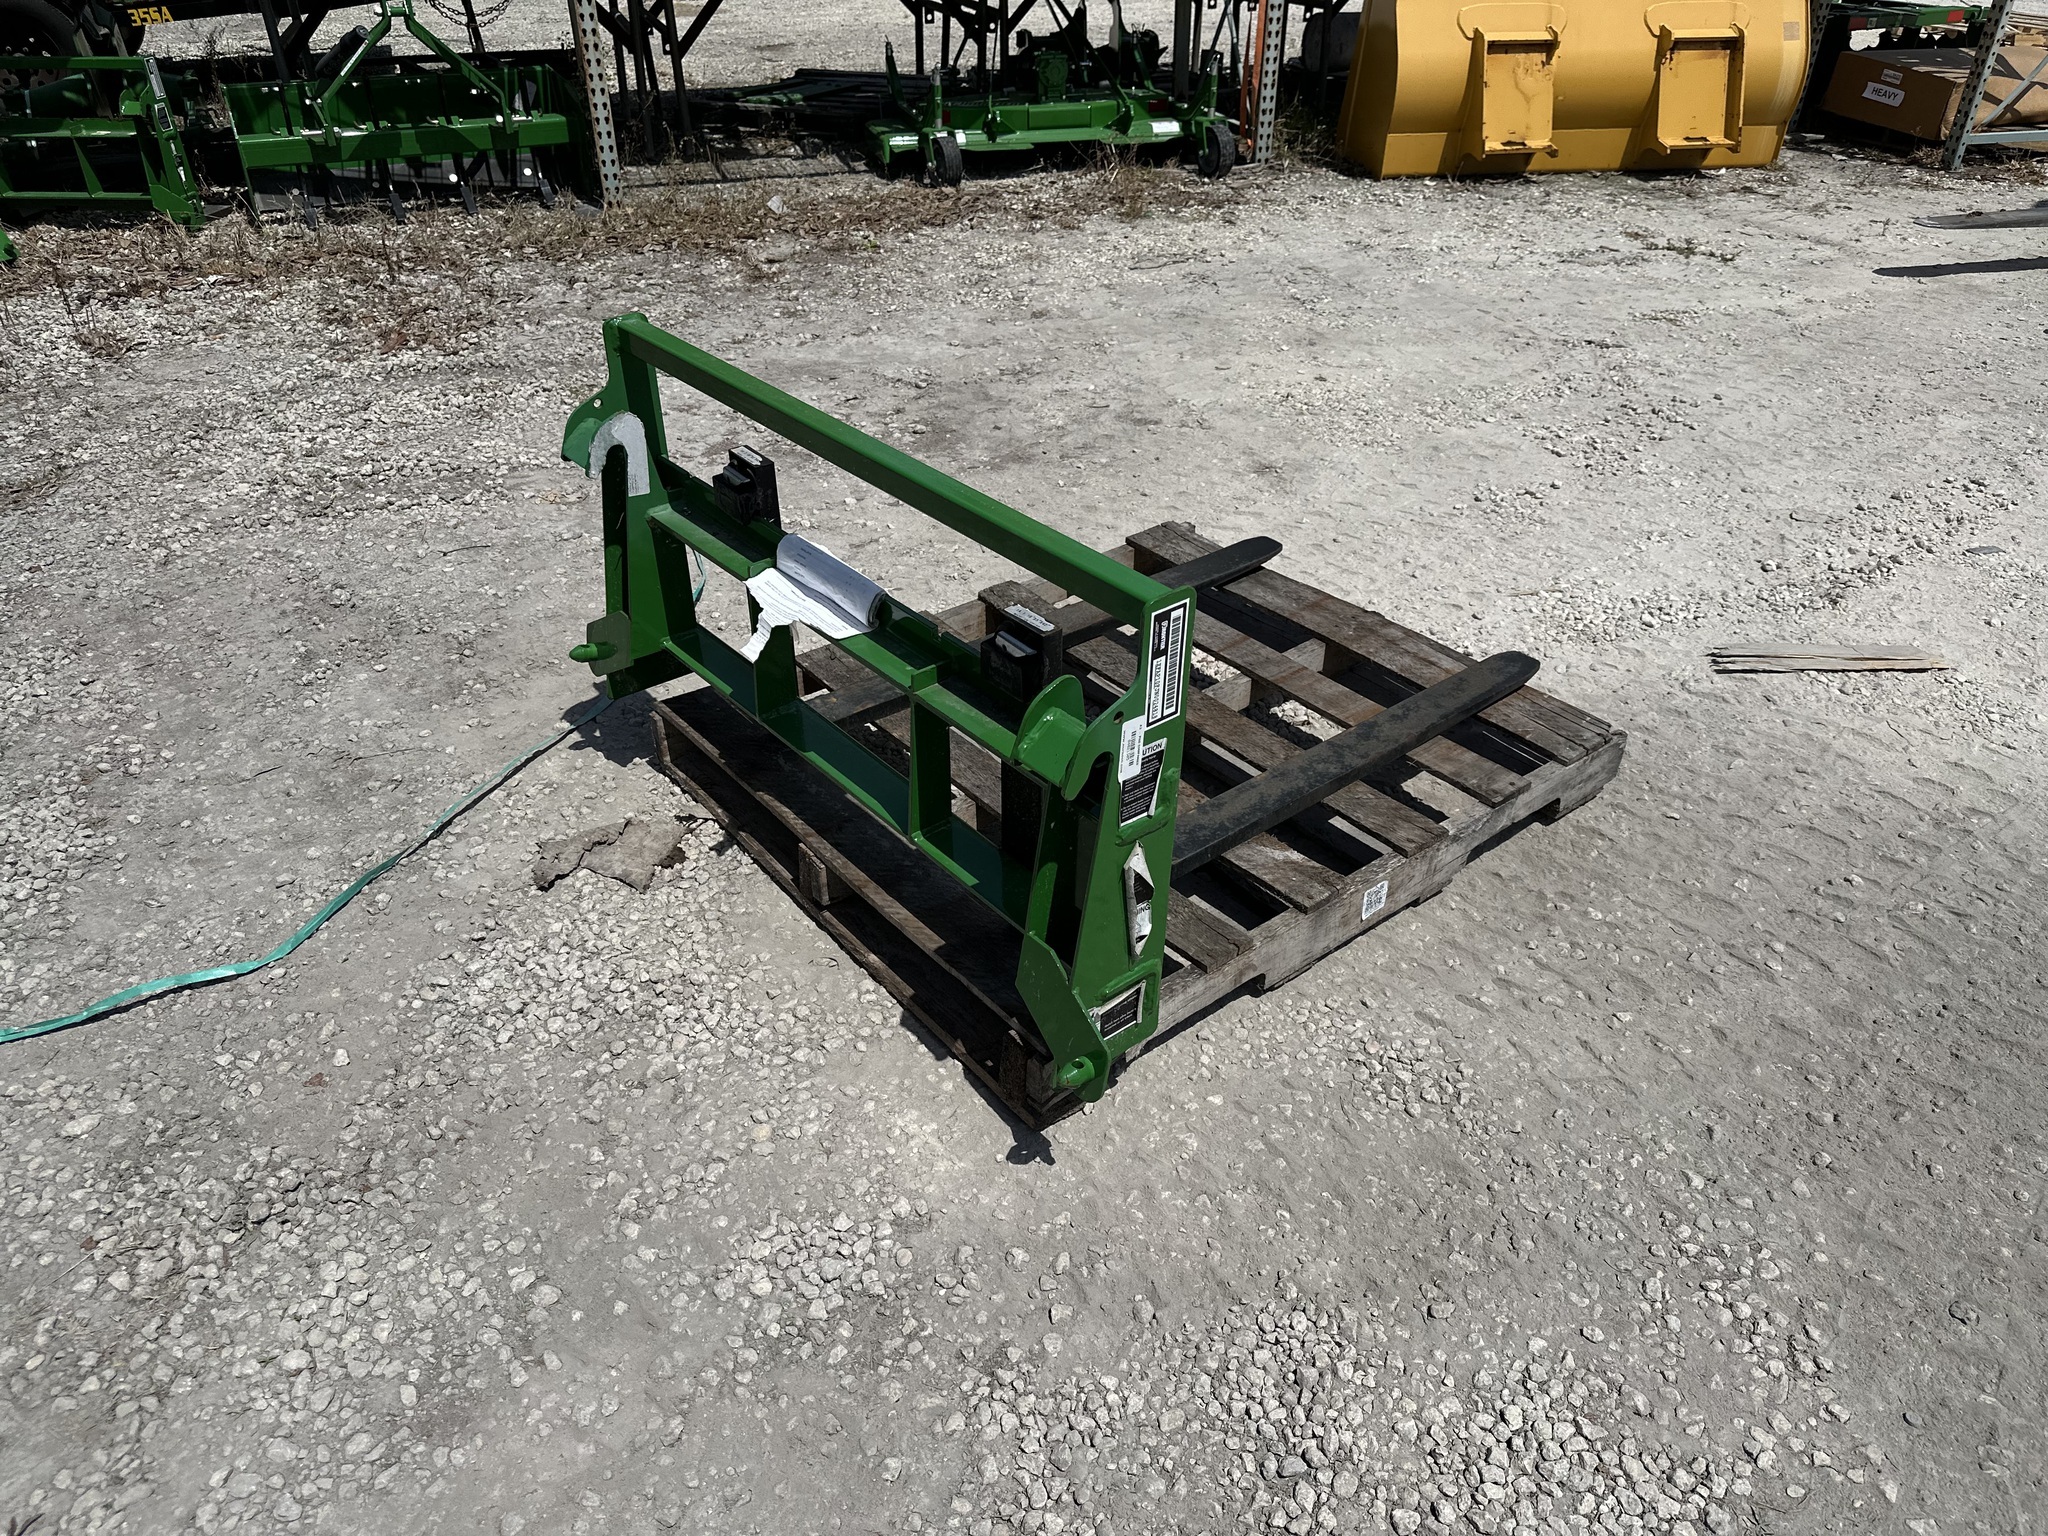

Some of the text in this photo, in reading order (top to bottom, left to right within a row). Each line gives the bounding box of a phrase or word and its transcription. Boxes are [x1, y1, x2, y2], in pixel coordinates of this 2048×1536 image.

[127, 6, 173, 26] 355A
[1871, 87, 1898, 100] HEAVY
[1142, 742, 1163, 756] UTION
